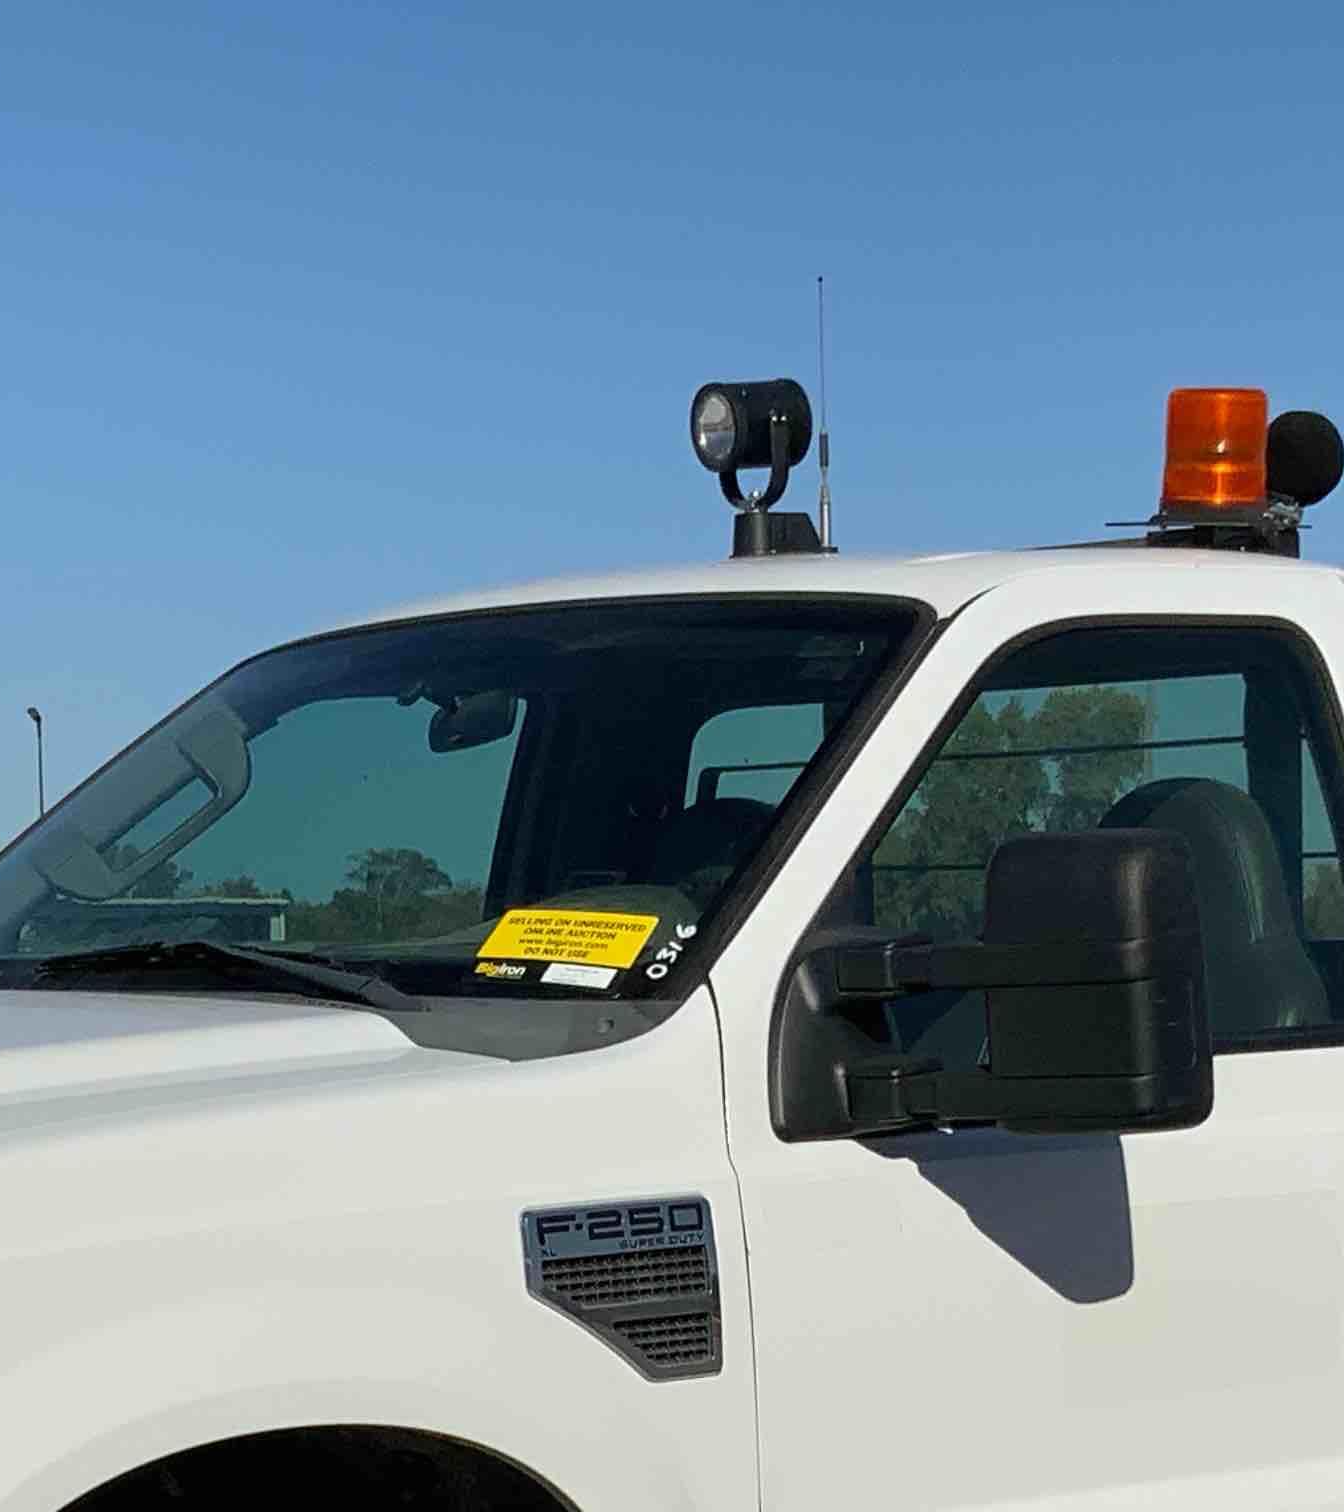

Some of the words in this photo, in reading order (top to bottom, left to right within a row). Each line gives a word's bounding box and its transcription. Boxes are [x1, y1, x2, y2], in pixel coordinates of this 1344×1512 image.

[509, 917, 553, 926] SELLING
[555, 918, 573, 927] ON
[575, 920, 647, 932] UNRESERVED
[523, 927, 565, 936] ONLINE
[568, 928, 617, 940] AUCTION
[523, 947, 540, 955] DO
[542, 948, 566, 957] NOT
[567, 949, 590, 959] USE
[646, 923, 697, 979] 0316
[474, 961, 527, 977] BigIron
[536, 1202, 704, 1246] F-250
[668, 1231, 705, 1246] DUTY
